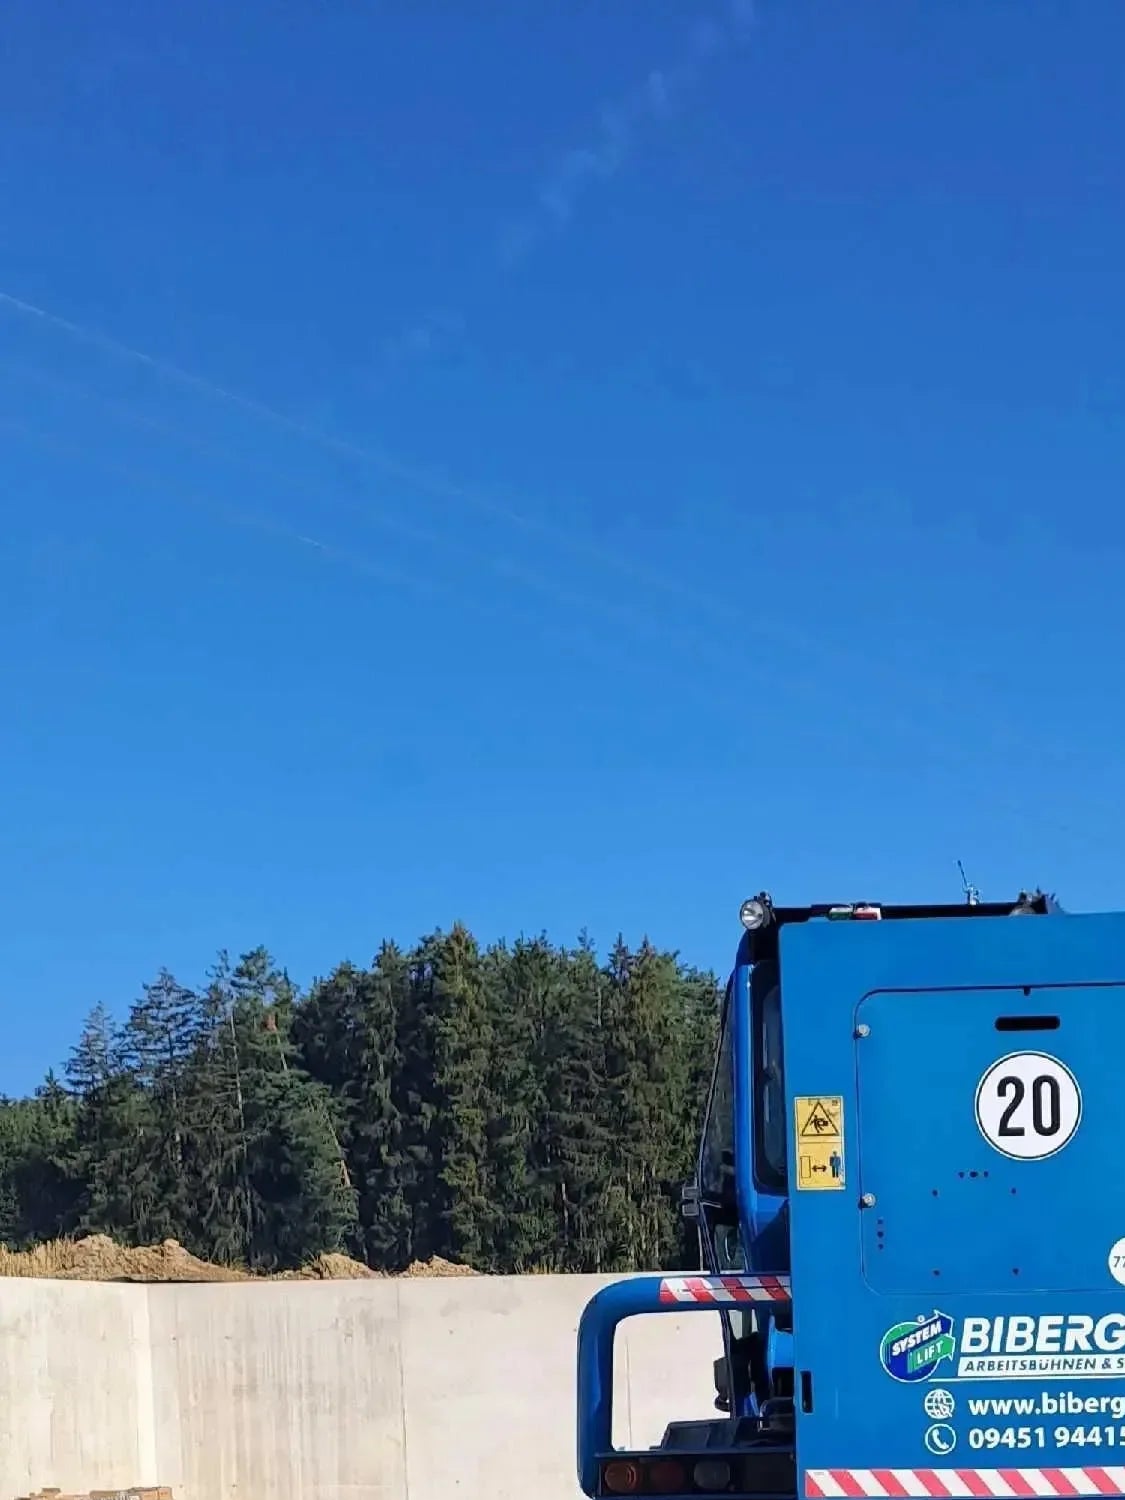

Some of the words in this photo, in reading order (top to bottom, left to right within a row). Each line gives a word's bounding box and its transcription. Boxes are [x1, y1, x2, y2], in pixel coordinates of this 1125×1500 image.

[997, 1074, 1061, 1137] 20
[892, 1319, 942, 1356] SYSTEM
[917, 1340, 943, 1364] LIFT
[964, 1357, 1097, 1372] ARBEITSBÜHNEN
[1101, 1357, 1112, 1369] &
[969, 1427, 1045, 1449] 09451
